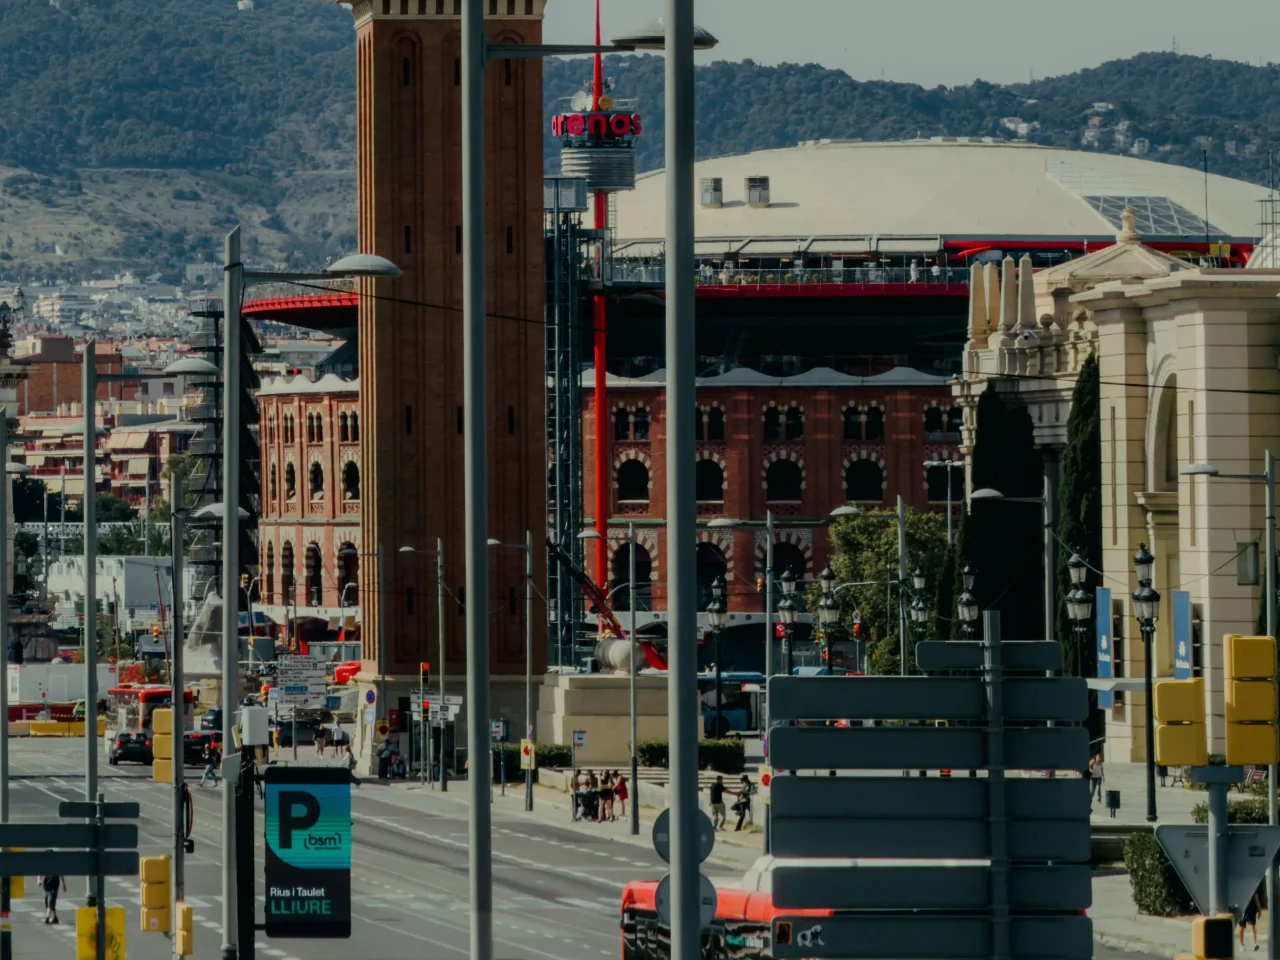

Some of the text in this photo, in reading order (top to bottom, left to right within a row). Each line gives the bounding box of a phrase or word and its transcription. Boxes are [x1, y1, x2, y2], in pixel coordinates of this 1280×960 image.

[551, 113, 641, 137] arenas
[278, 791, 320, 849] P
[308, 832, 336, 846] bsm
[270, 887, 291, 897] Rius
[296, 887, 325, 897] Taulet
[271, 899, 332, 915] LLIURE
